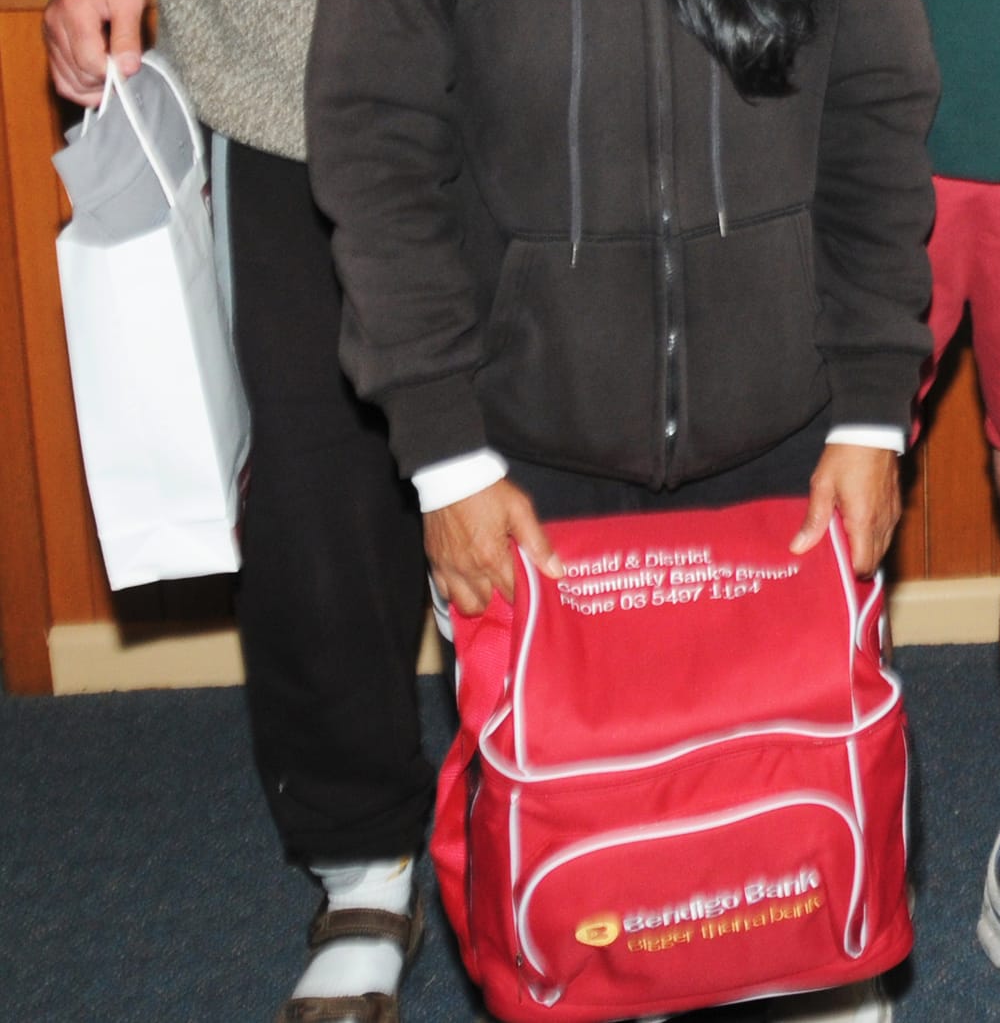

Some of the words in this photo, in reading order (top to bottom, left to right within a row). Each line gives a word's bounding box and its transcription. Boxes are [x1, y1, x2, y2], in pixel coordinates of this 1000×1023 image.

[624, 553, 641, 570] &
[645, 548, 714, 568] District
[557, 571, 666, 596] Community
[560, 592, 616, 616] Phone
[620, 590, 647, 611] 03
[622, 892, 741, 933] Bendigo
[743, 869, 820, 906] Bank
